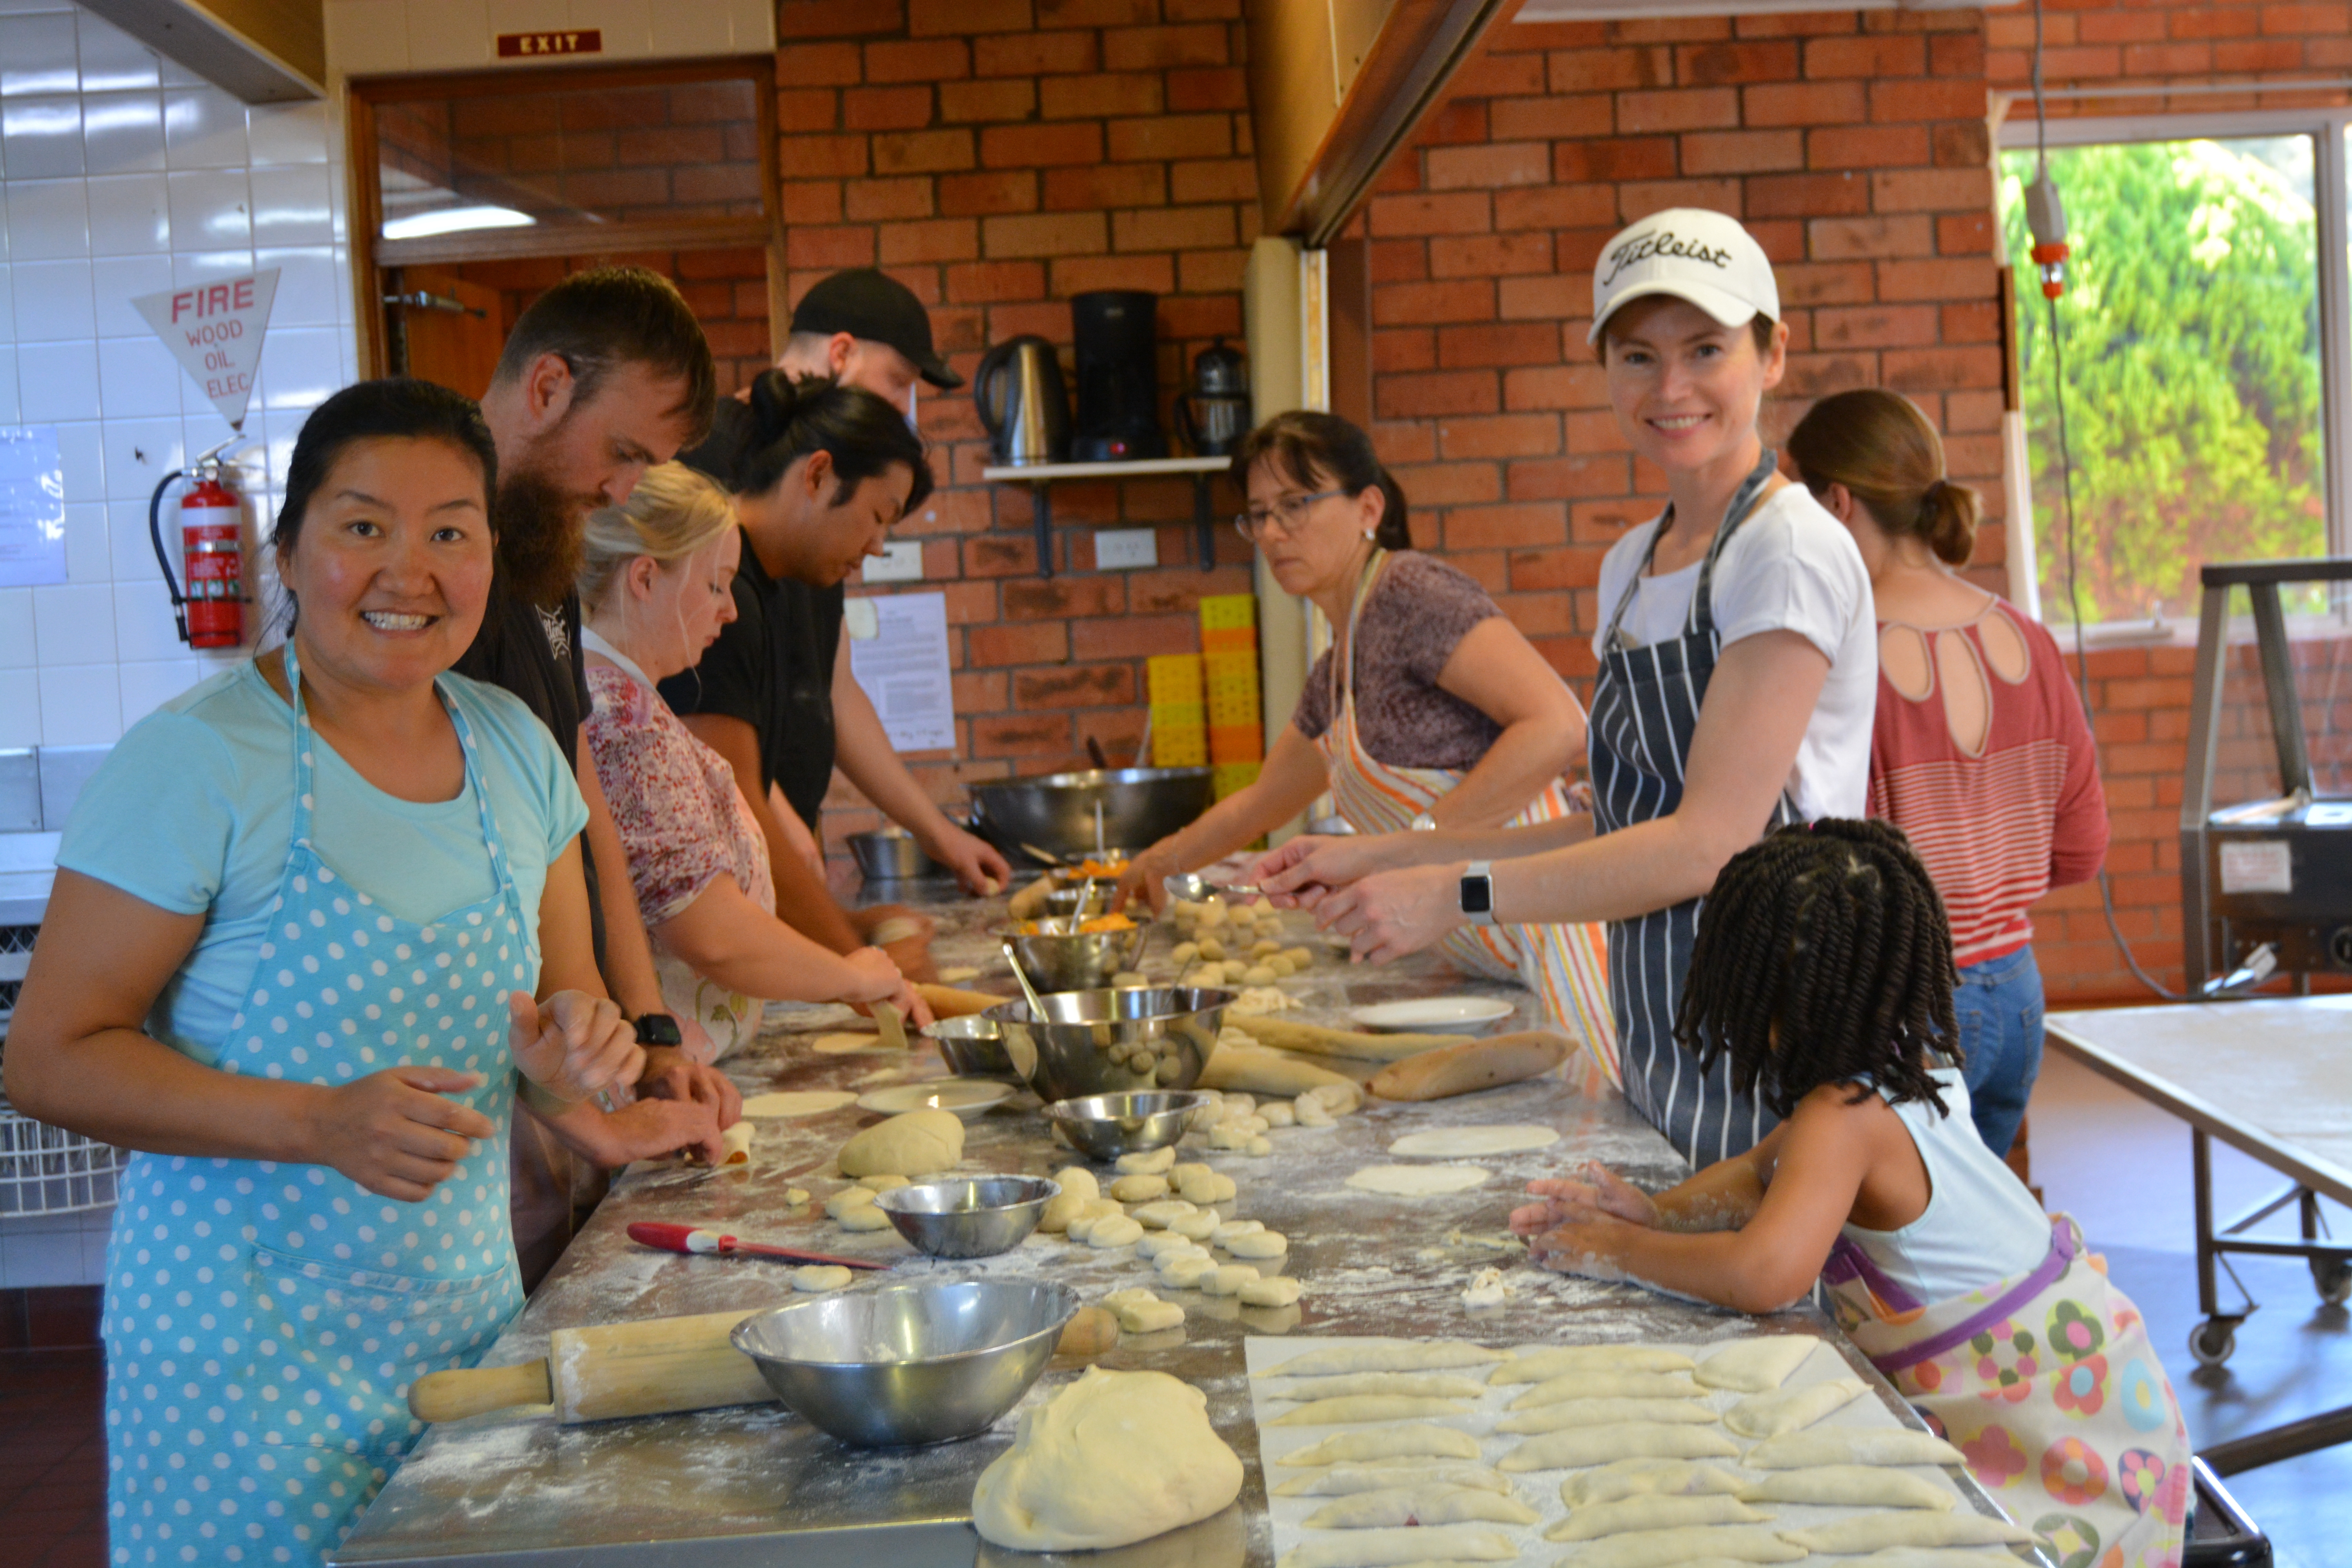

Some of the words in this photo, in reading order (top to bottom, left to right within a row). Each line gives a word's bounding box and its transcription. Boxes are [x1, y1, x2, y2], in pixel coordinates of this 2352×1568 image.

[520, 34, 579, 53] EXIT
[1603, 228, 1732, 286] Titleist
[172, 278, 255, 324] FIRE
[185, 319, 243, 347] WOOD
[205, 350, 235, 371] OIL
[206, 372, 249, 399] ELEC
